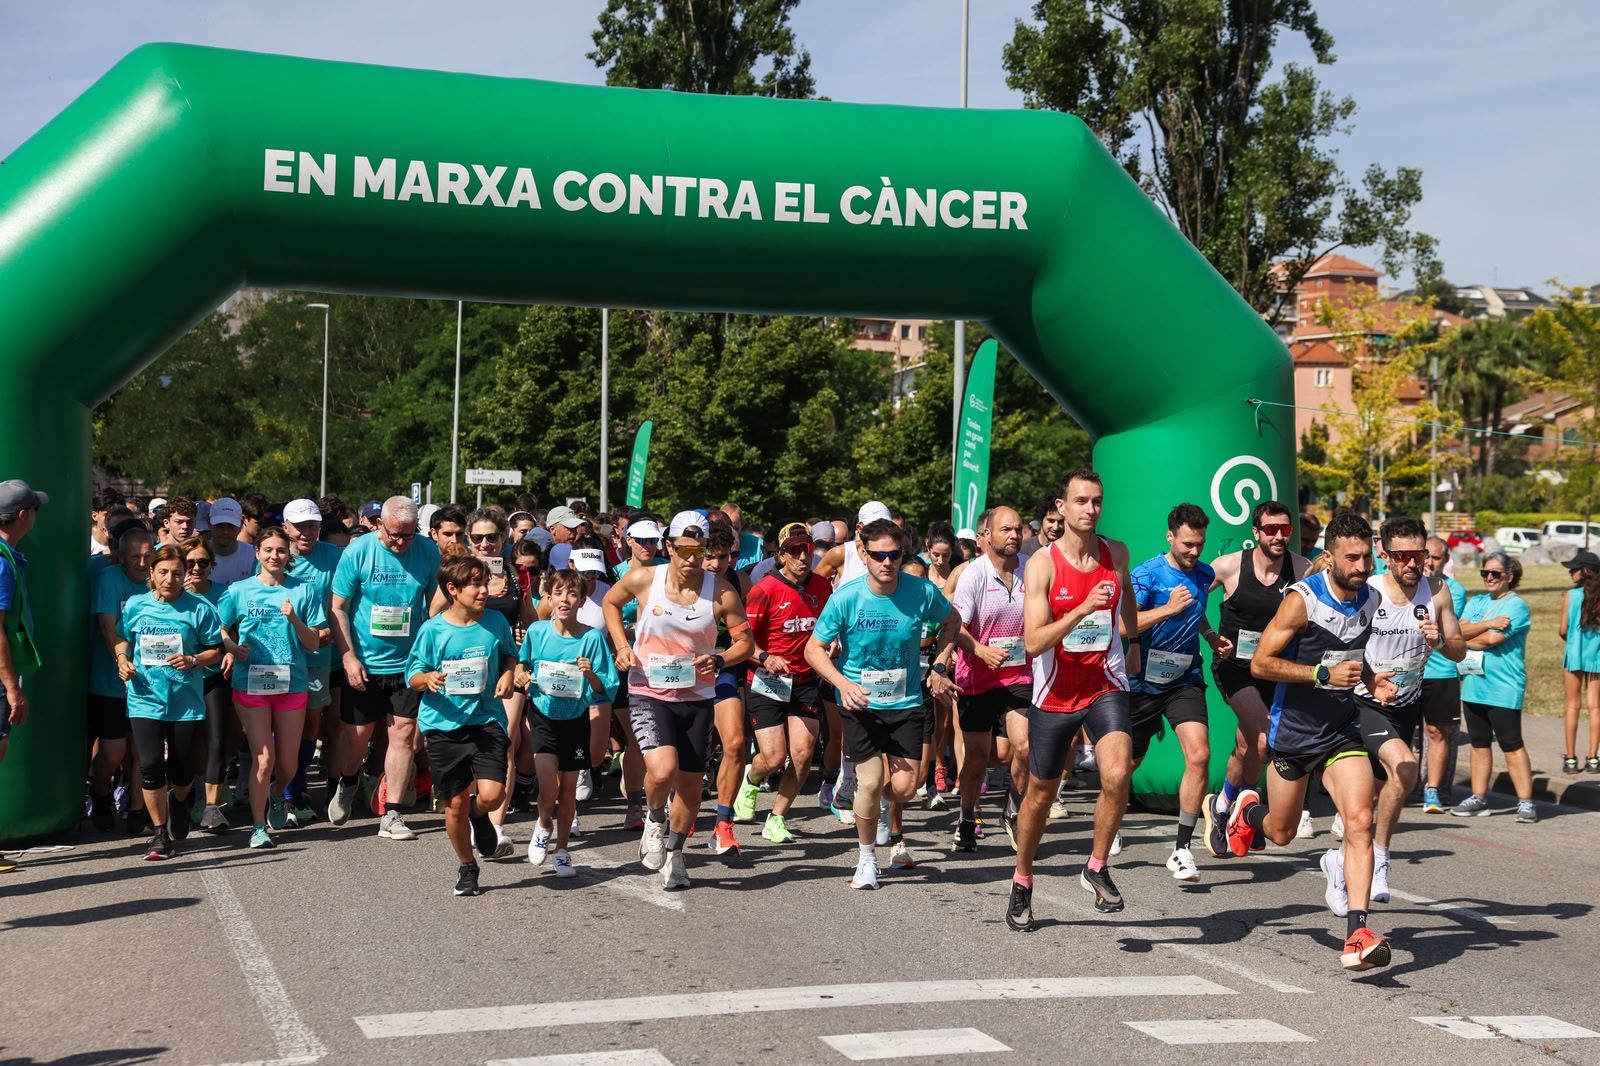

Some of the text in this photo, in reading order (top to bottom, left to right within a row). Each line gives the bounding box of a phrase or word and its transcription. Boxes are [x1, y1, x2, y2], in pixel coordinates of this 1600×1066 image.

[263, 149, 1029, 230] EN MARXA CONTRA EL CÀNCER
[373, 573, 389, 583] KM
[247, 608, 265, 617] KM
[857, 618, 877, 629] KM
[1371, 626, 1409, 637] Ripollet
[1080, 636, 1097, 645] 209
[156, 653, 166, 661] 50
[664, 675, 680, 683] 295
[1160, 671, 1175, 679] 507
[460, 680, 476, 689] 558
[551, 683, 566, 691] 557
[877, 690, 892, 698] 296
